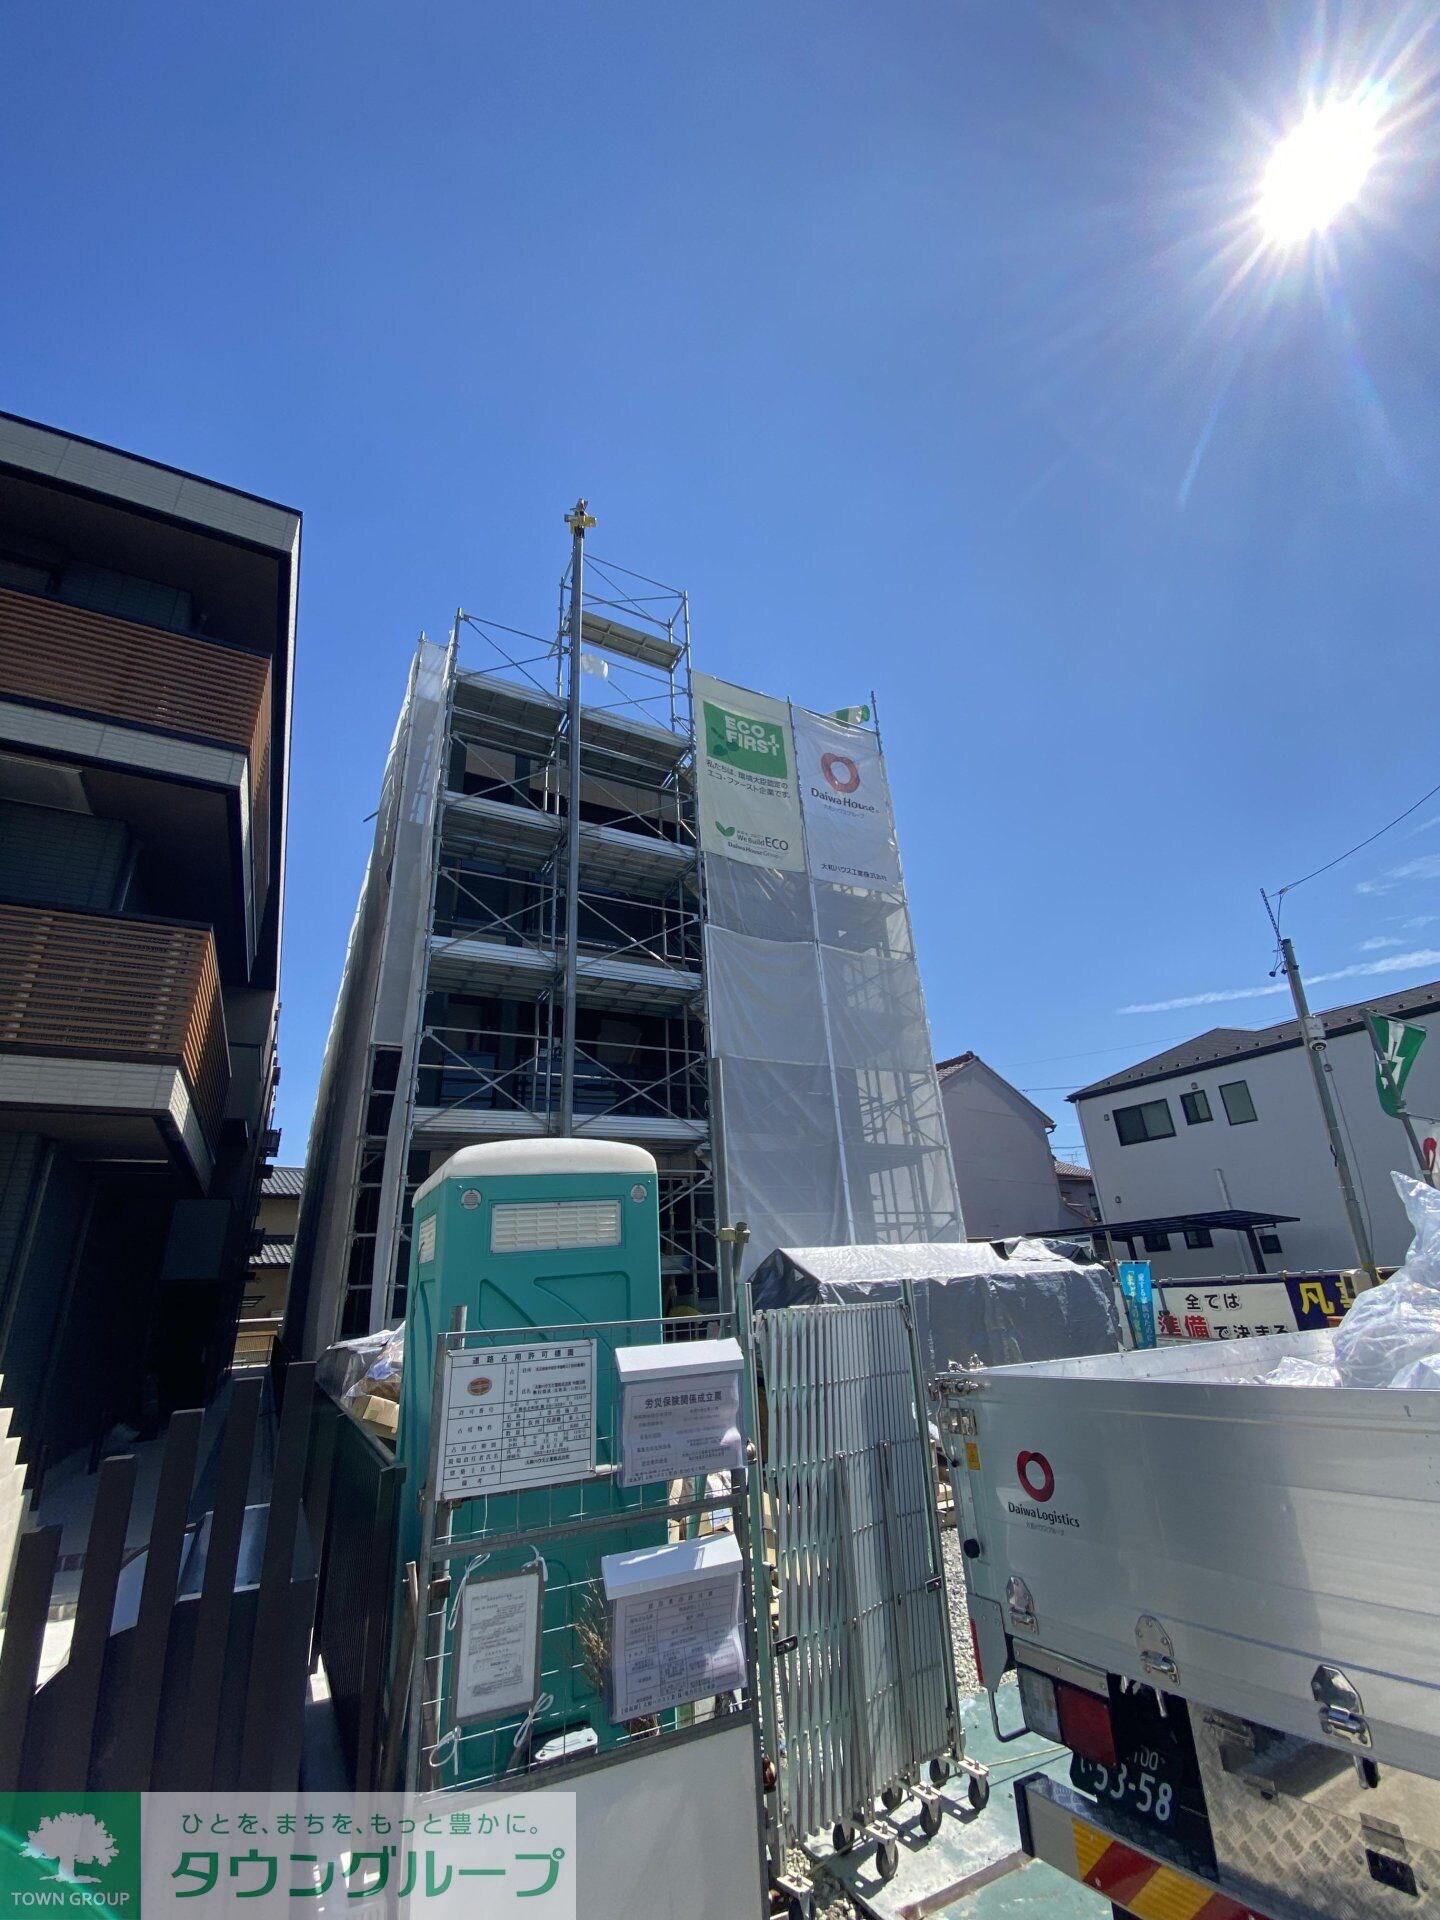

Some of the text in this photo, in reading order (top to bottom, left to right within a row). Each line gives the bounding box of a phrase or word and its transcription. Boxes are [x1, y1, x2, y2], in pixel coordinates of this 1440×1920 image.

[724, 714, 766, 739] ECO
[726, 729, 781, 757] FIRST
[765, 836, 789, 851] ECO
[1185, 1292, 1241, 1311] 全ては
